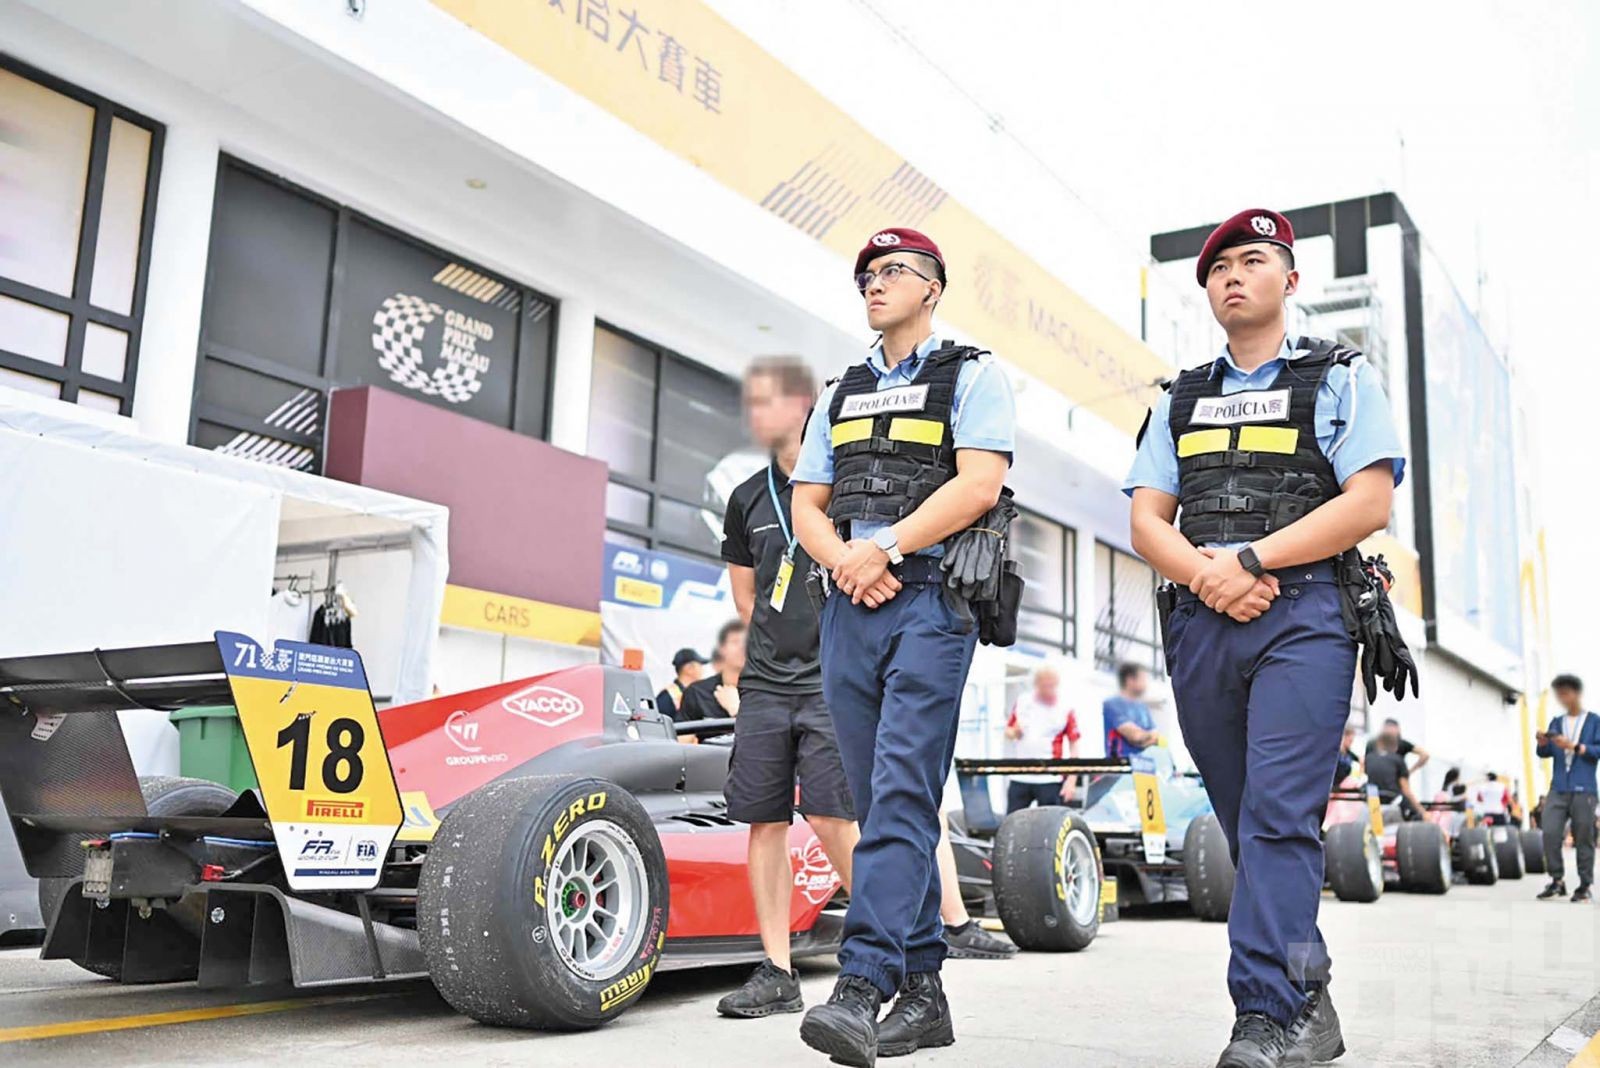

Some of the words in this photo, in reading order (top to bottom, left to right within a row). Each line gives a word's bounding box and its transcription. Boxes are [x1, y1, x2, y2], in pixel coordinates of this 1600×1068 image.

[442, 325, 477, 351] PRIX
[444, 309, 494, 341] GRAND
[440, 342, 491, 374] MACAU
[483, 601, 531, 628] CARS
[233, 642, 257, 669] 71
[511, 697, 576, 713] YACCO
[276, 713, 365, 794] 18
[306, 799, 365, 819] PIRELLI
[1146, 788, 1155, 821] 8
[540, 791, 608, 868] ZERO
[600, 964, 652, 1012] PIRELLI
